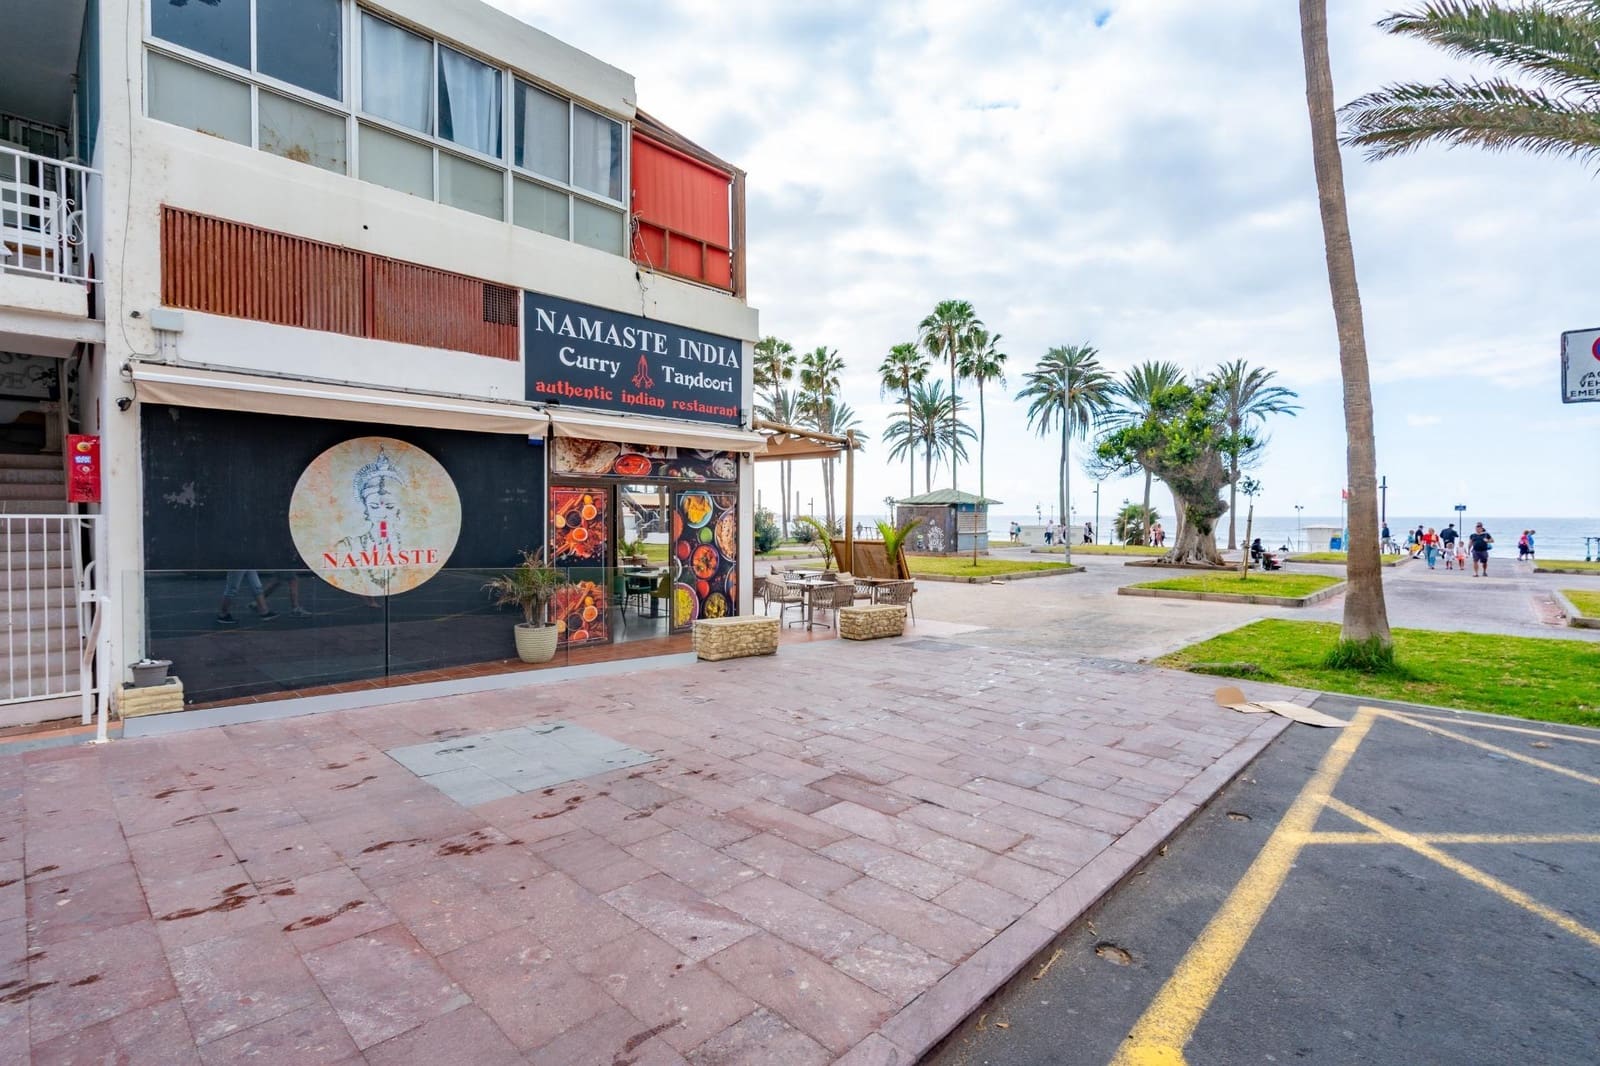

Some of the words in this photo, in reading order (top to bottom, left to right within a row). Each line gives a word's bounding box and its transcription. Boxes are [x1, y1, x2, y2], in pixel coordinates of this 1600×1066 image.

[535, 308, 668, 355] NAMASTE
[679, 338, 740, 368] INDIA
[559, 346, 621, 379] Curry
[661, 365, 733, 393] Tandoori
[535, 379, 613, 401] authentic
[621, 389, 665, 409] indian
[672, 399, 738, 418] restaurant
[322, 549, 438, 568] NAMASTE
